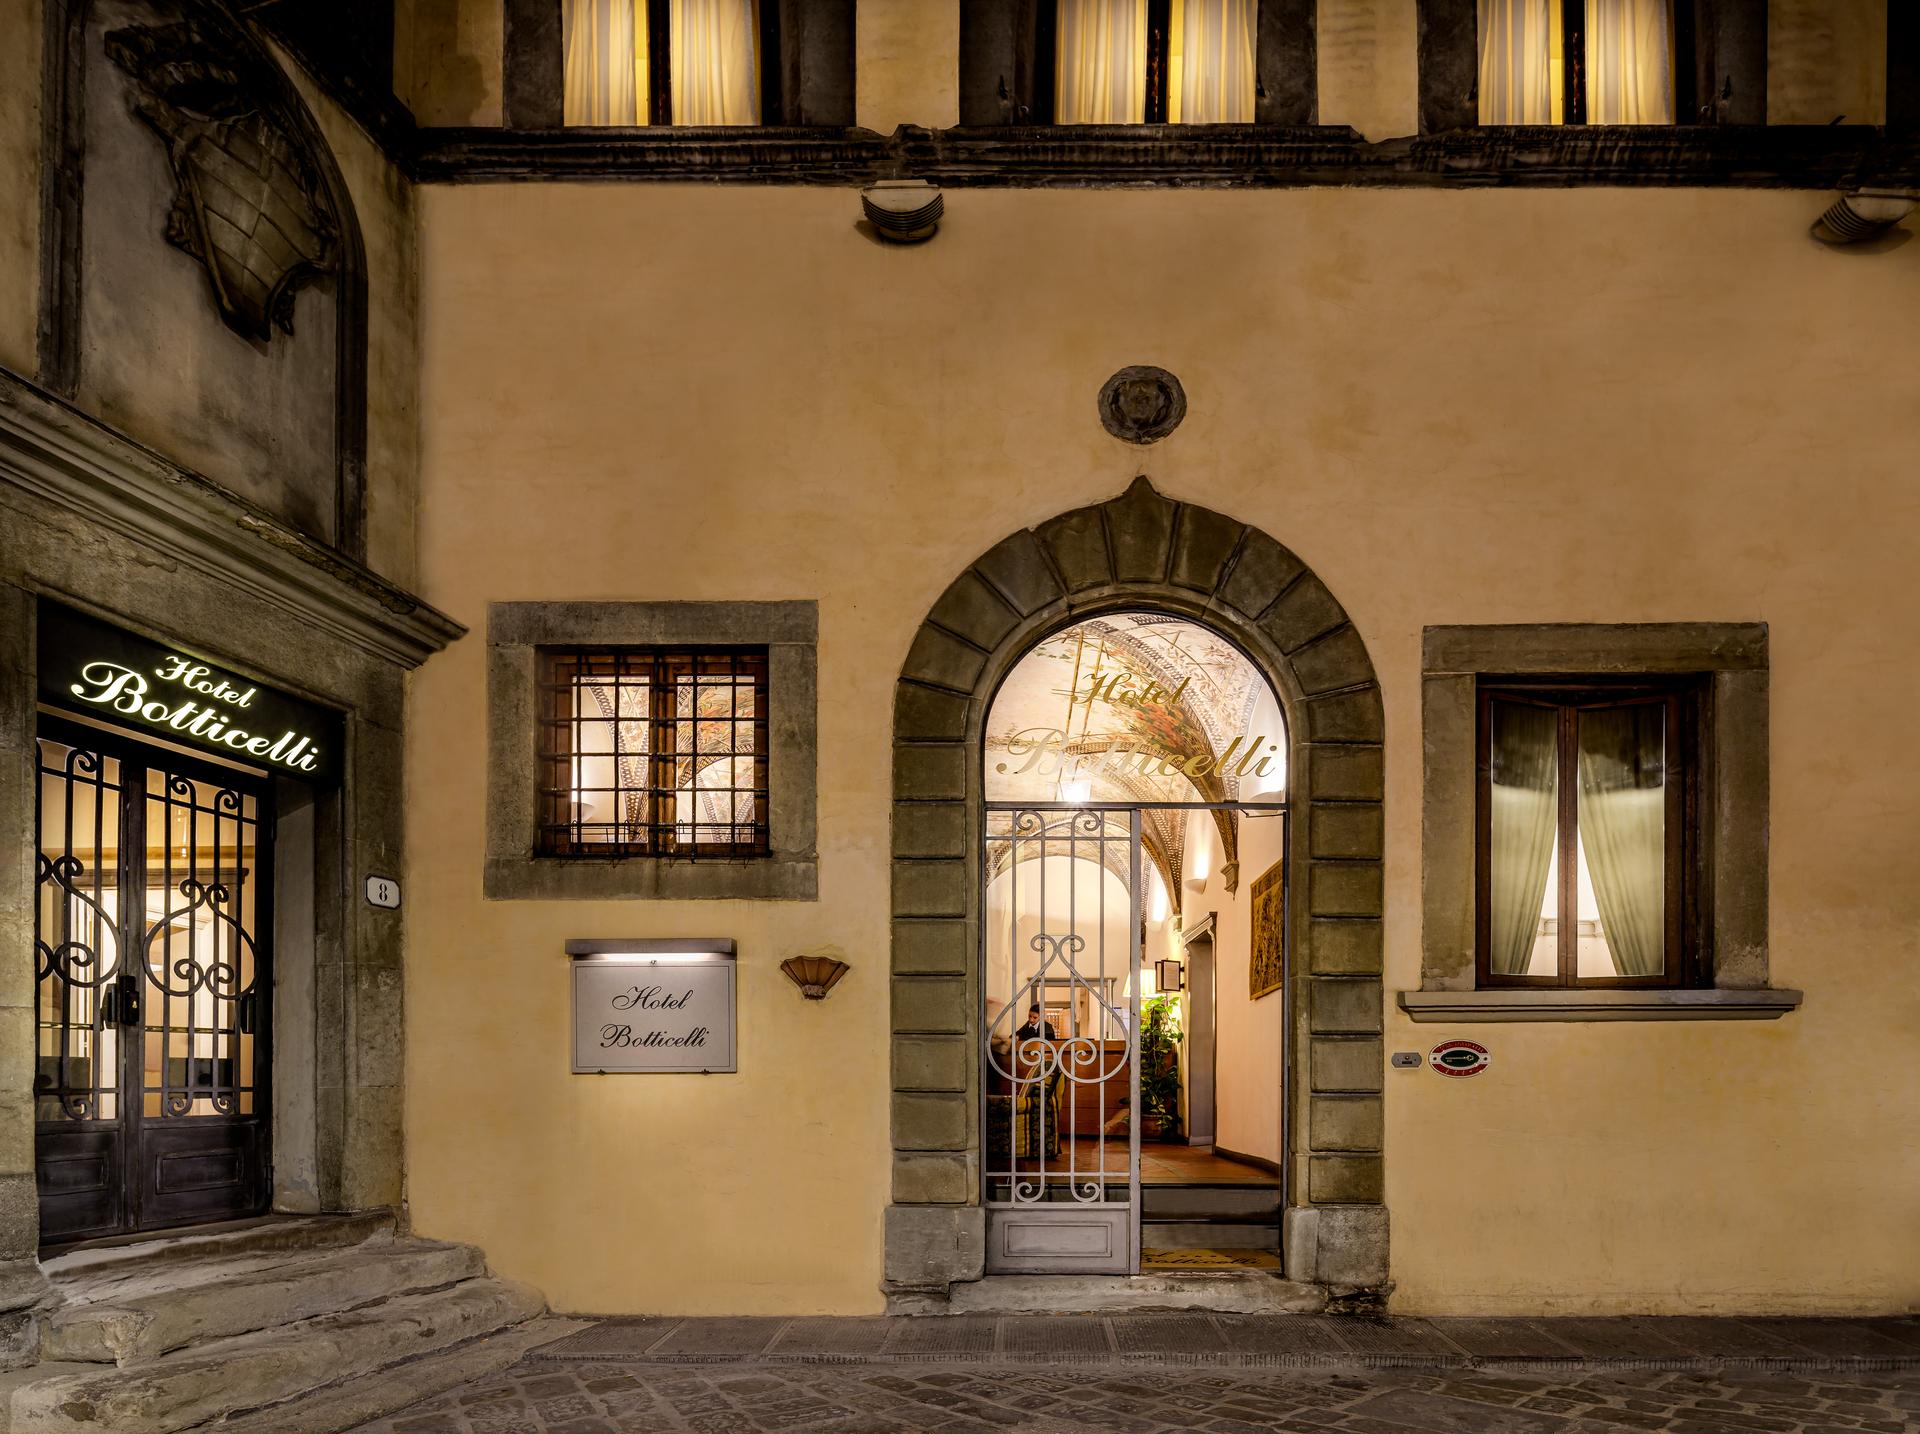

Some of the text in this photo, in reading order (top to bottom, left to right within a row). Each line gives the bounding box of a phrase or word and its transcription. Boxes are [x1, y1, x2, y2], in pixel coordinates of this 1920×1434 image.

[155, 656, 257, 708] Hotel
[1070, 672, 1192, 705] Hotel
[71, 661, 318, 772] Botticelli
[378, 883, 388, 902] 8
[611, 986, 694, 1010] Hotel
[600, 1023, 710, 1048] Botticelli
